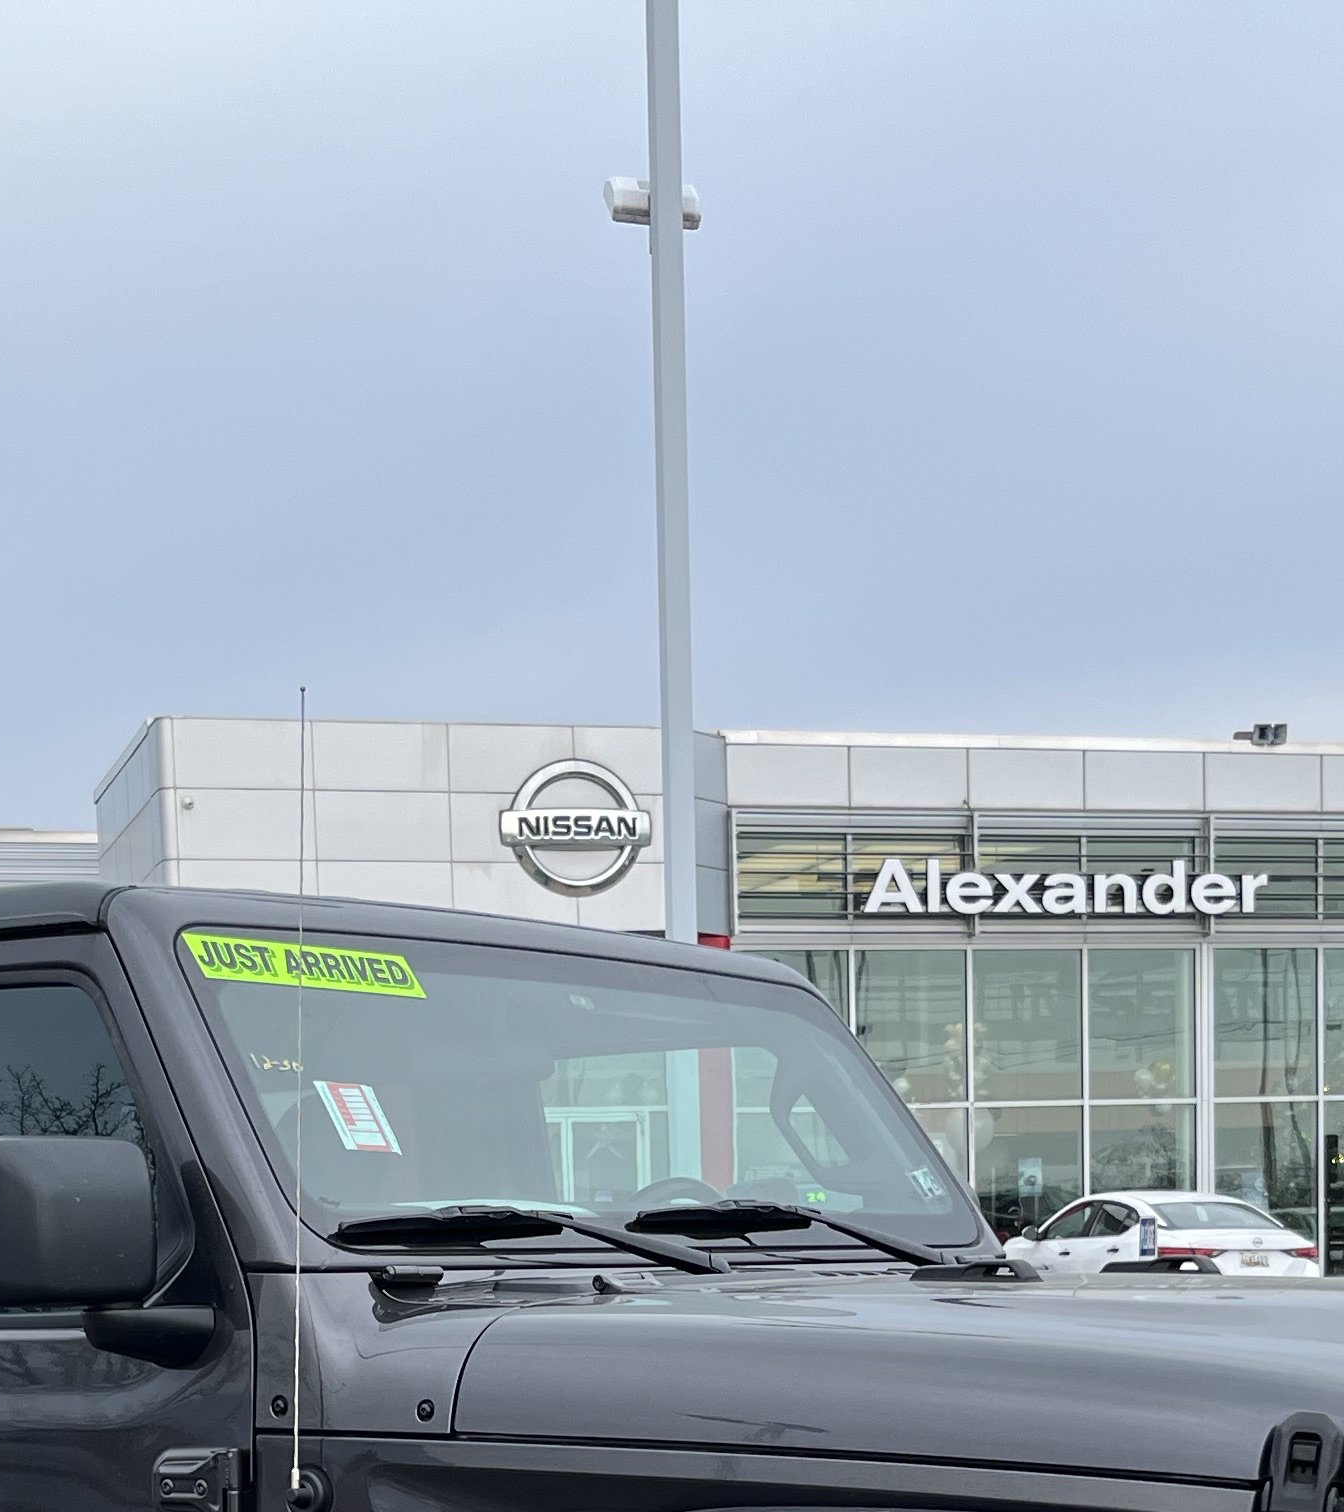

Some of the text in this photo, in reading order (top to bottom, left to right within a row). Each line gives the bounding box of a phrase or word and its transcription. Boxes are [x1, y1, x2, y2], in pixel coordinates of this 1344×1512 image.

[517, 815, 637, 839] NISSAN
[863, 857, 1268, 914] Alexander
[197, 940, 414, 990] JUST ARRIVED
